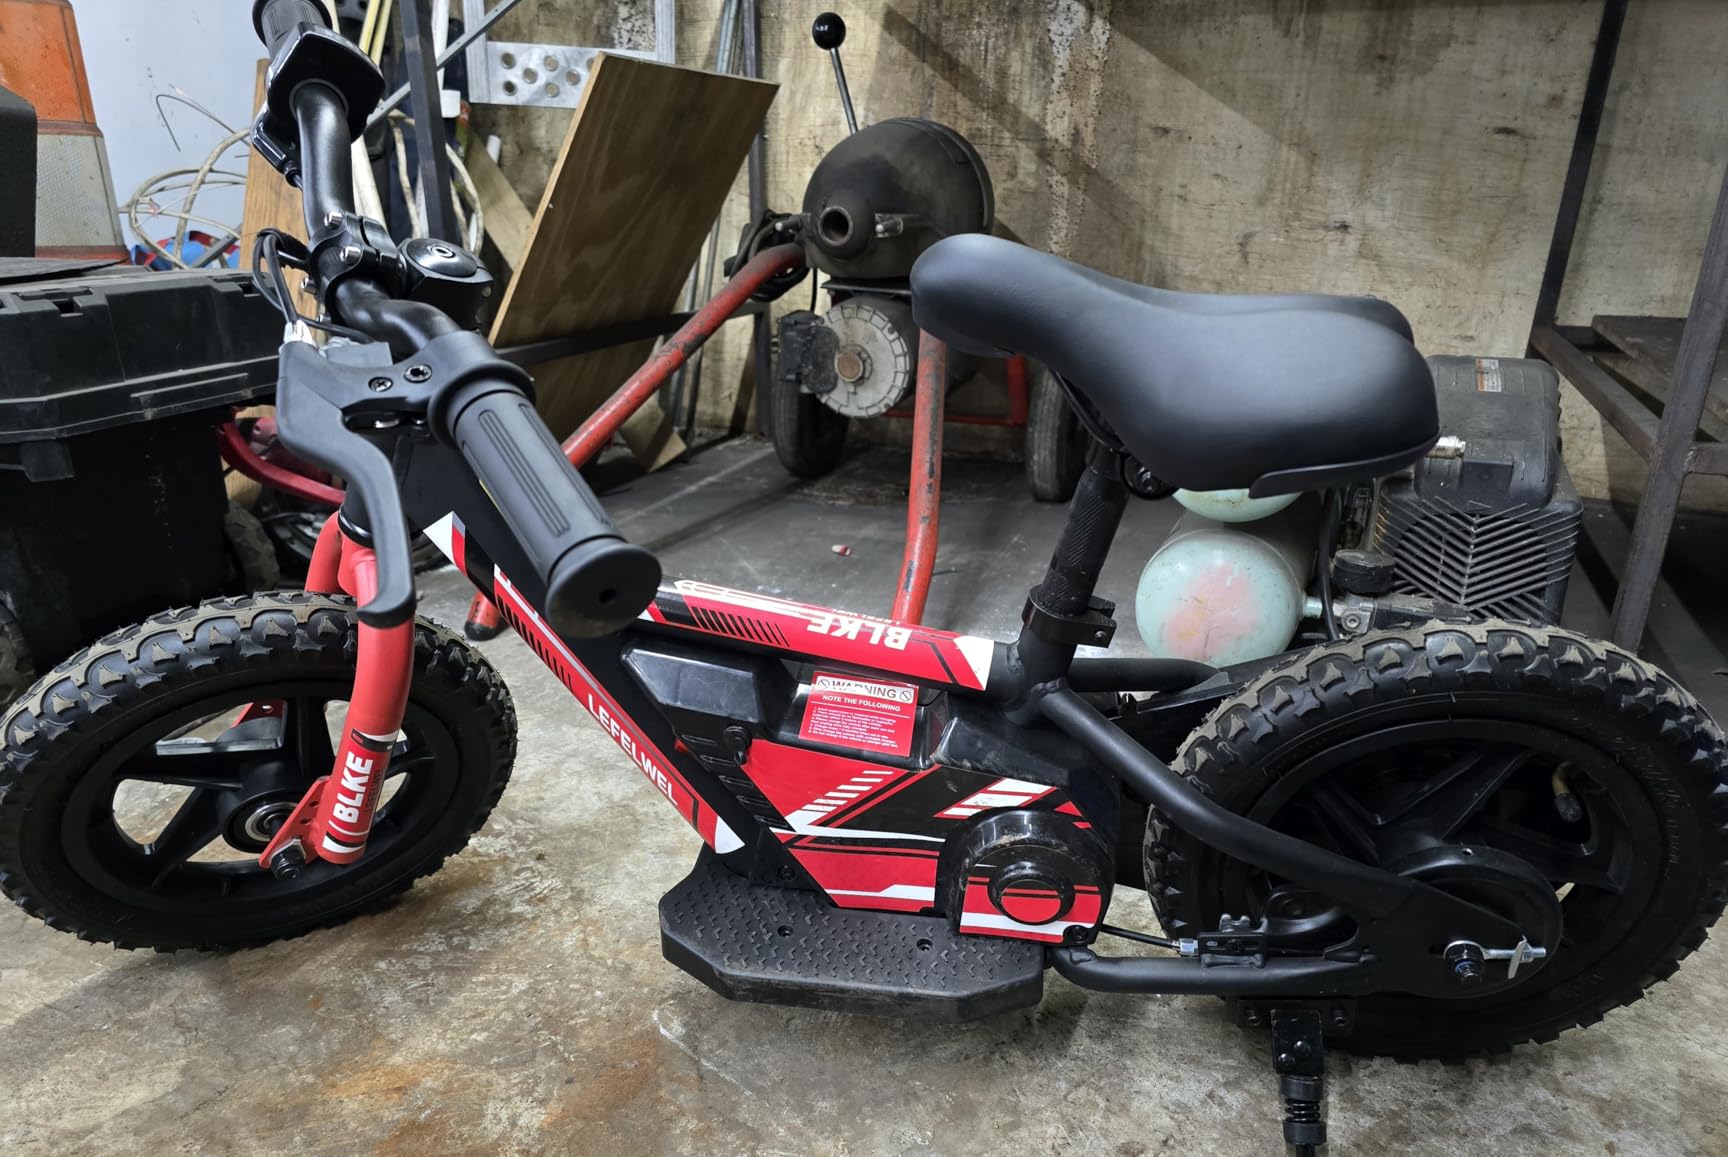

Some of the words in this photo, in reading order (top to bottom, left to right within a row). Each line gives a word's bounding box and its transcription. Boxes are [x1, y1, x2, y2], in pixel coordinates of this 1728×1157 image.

[806, 617, 912, 650] BLKE
[822, 694, 842, 704] NOTE
[844, 697, 858, 706] THE
[858, 699, 901, 712] FOLLOWING
[588, 693, 678, 806] LEFELWEL
[333, 751, 373, 823] BLKE
